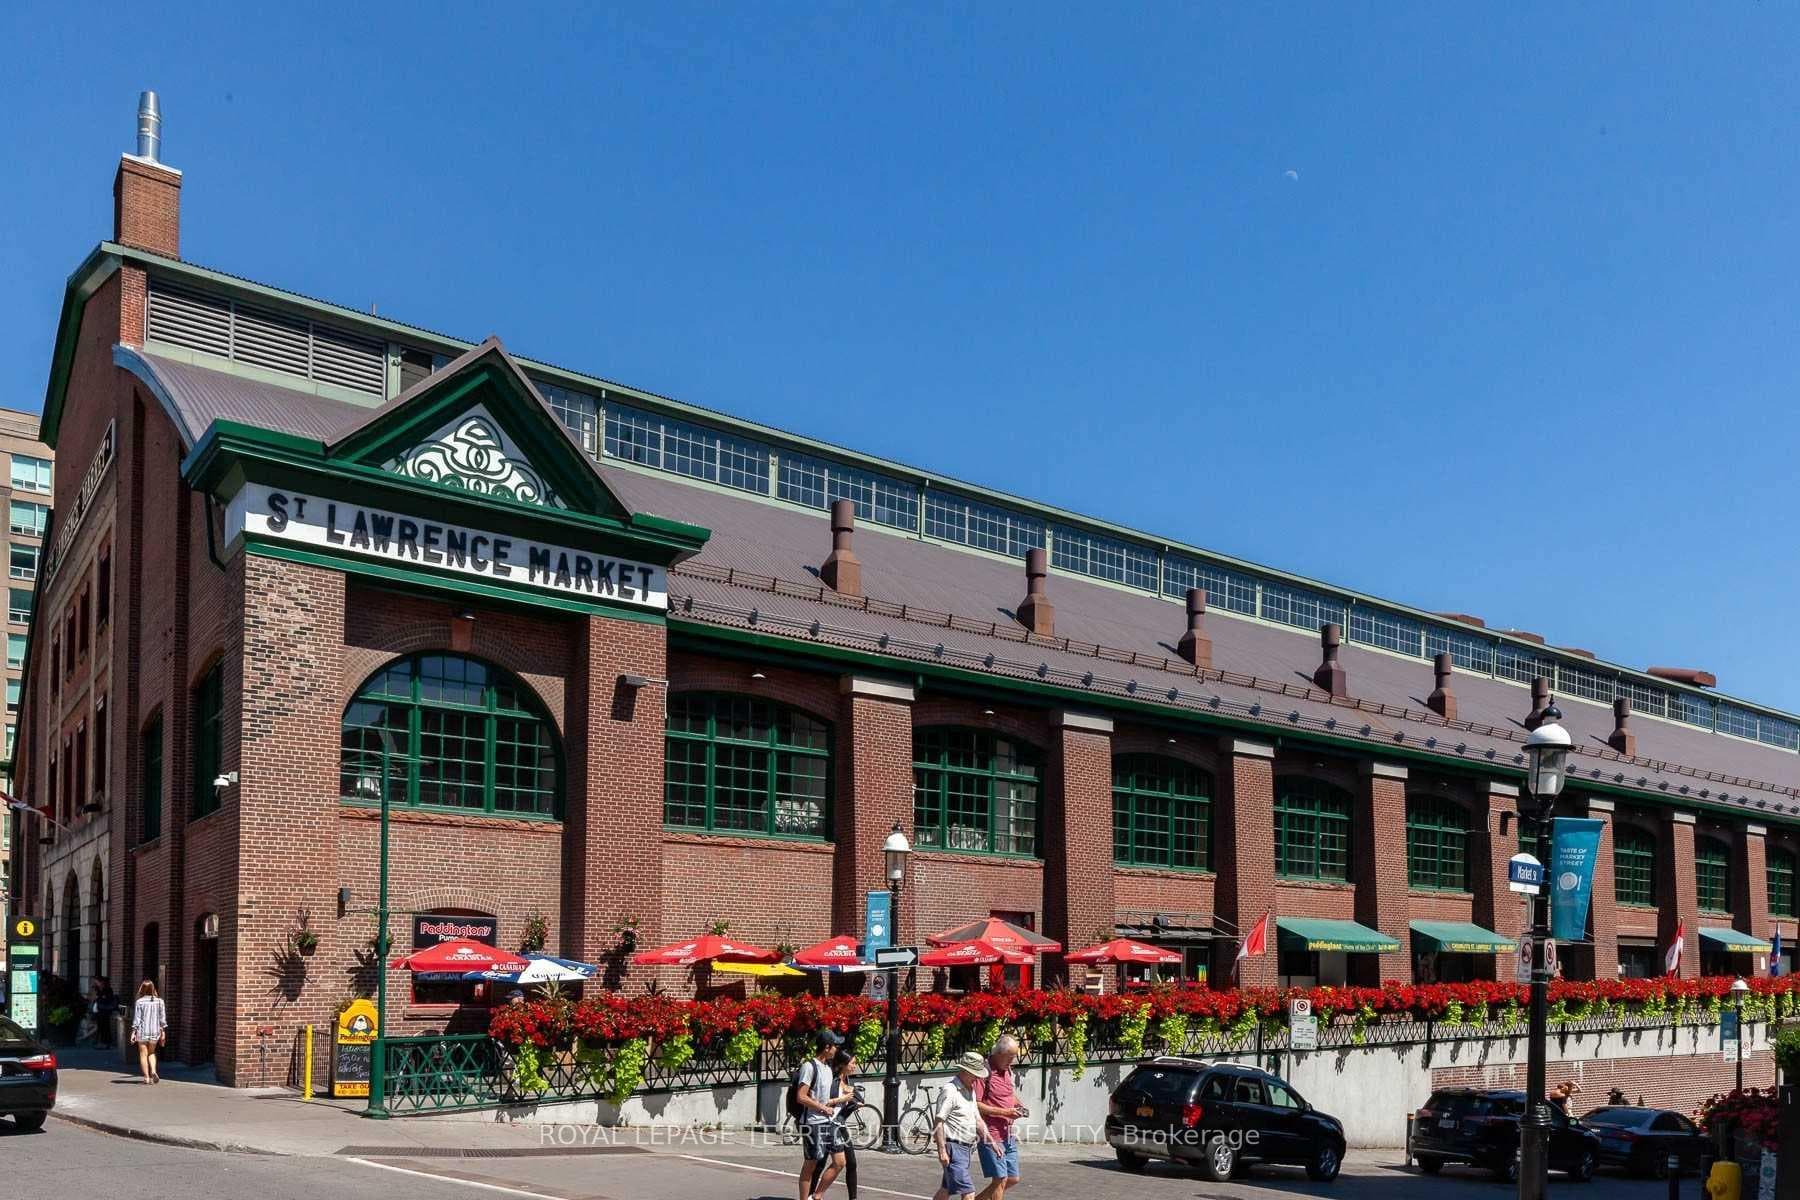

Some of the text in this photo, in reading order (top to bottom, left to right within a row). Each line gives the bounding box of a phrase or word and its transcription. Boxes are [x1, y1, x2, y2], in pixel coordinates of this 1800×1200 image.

[325, 503, 512, 576] LAWRENCE
[528, 545, 654, 602] MARKET
[1517, 865, 1532, 880] Market
